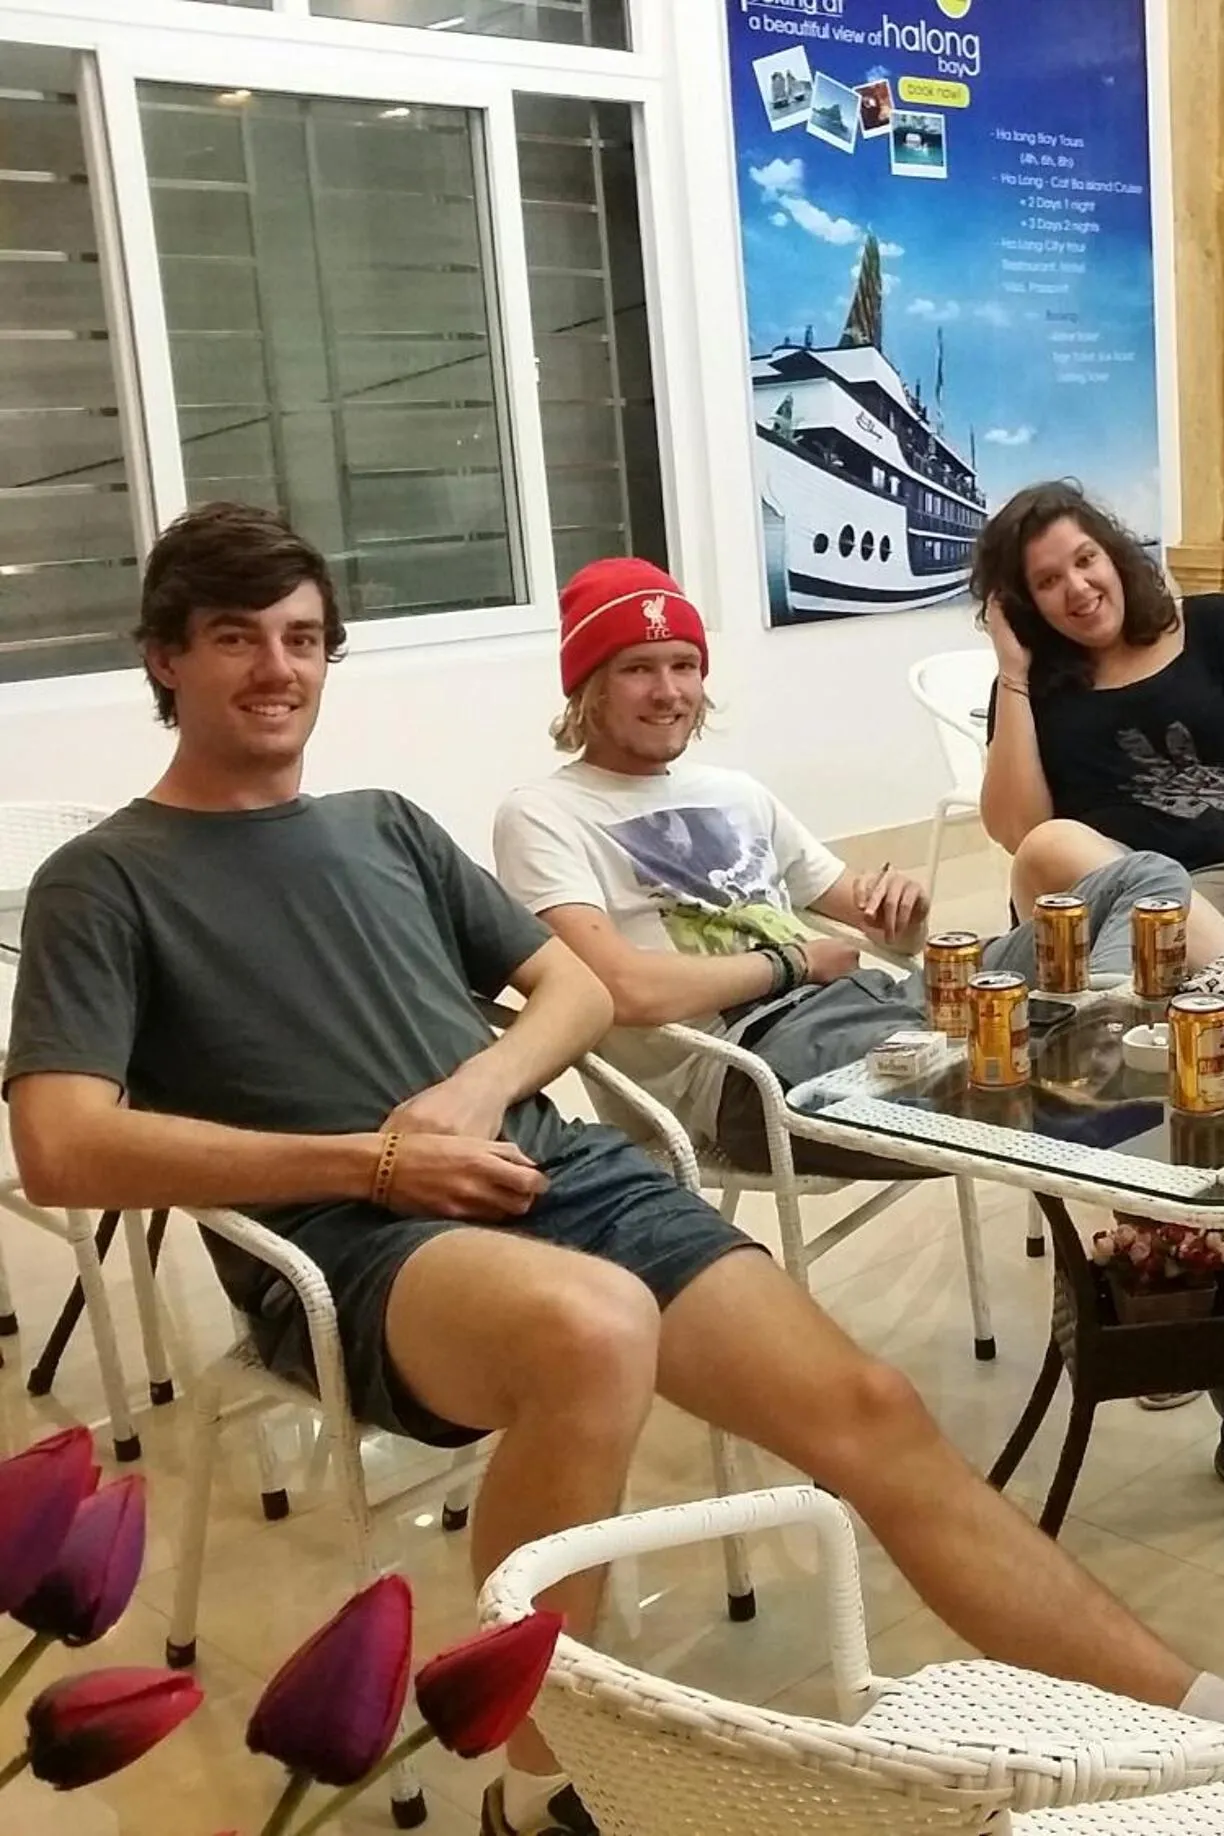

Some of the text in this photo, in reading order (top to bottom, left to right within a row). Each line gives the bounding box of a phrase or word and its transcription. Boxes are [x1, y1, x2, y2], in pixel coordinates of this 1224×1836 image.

[748, 14, 980, 76] a beautiful view of halong
[938, 56, 966, 78] bay
[1037, 132, 1057, 147] Bay
[1018, 174, 1043, 189] Long
